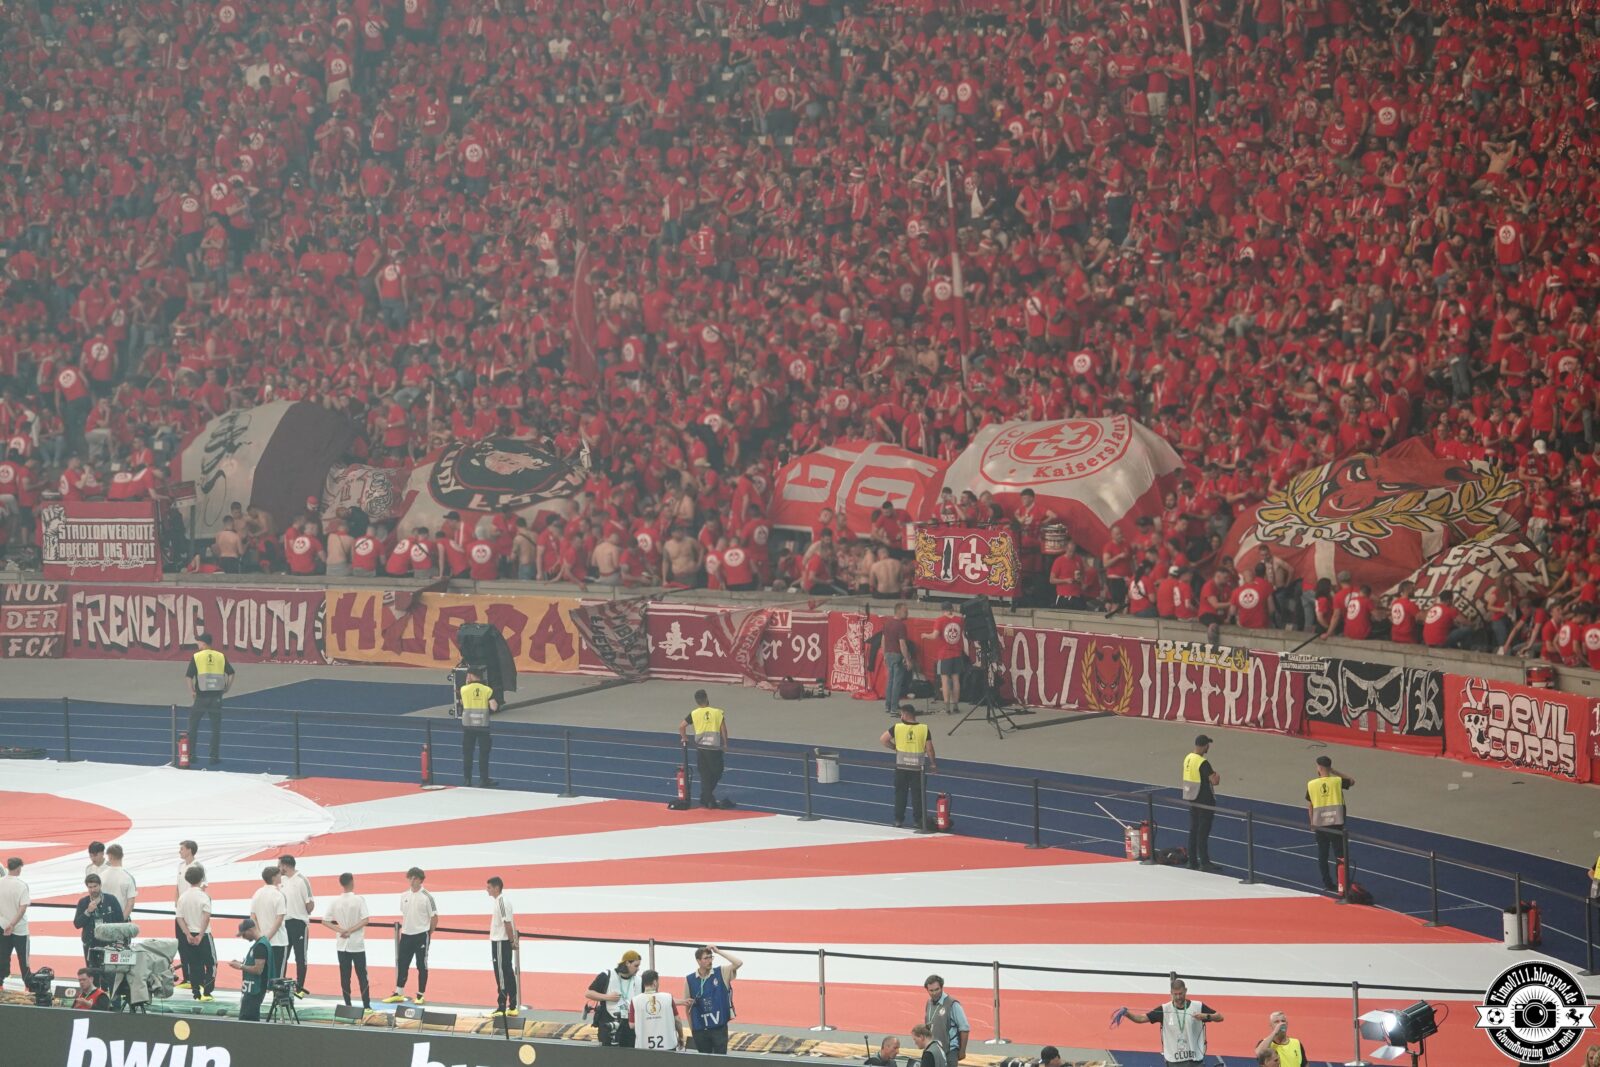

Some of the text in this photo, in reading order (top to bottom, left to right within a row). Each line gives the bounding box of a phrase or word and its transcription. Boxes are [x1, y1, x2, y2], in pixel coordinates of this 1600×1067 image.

[58, 524, 155, 540] STADIONVERBOTE
[60, 542, 155, 558] BRECHEN UNS NICHT
[5, 584, 59, 601] NUR
[6, 610, 58, 629] DER
[71, 591, 204, 652] FRENETIC
[216, 596, 307, 653] YOUTH
[8, 637, 58, 656] FCK
[1157, 639, 1233, 667] PFALZ
[1487, 726, 1575, 774] CORPS
[701, 1011, 720, 1026] TV
[66, 1018, 231, 1067] bwin
[648, 1036, 664, 1049] 52
